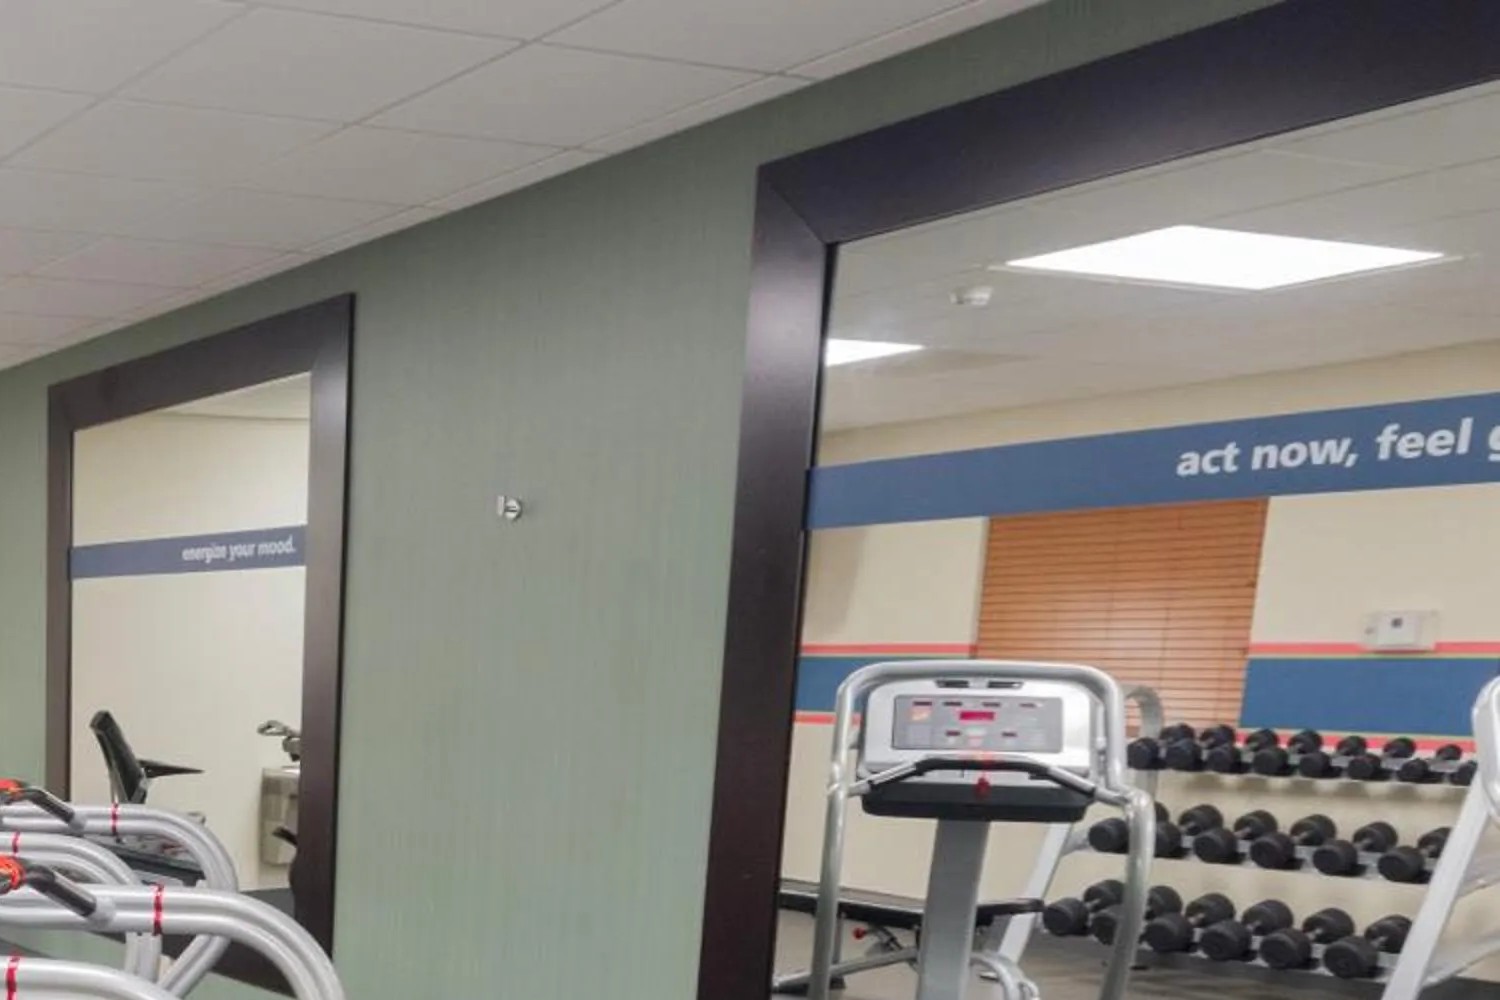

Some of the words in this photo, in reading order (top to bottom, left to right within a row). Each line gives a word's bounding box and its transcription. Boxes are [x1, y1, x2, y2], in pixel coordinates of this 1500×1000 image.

[1176, 441, 1241, 477] act
[1250, 437, 1359, 468] now,
[1375, 416, 1474, 461] feel
[229, 542, 256, 562] your
[257, 534, 297, 556] mood.
